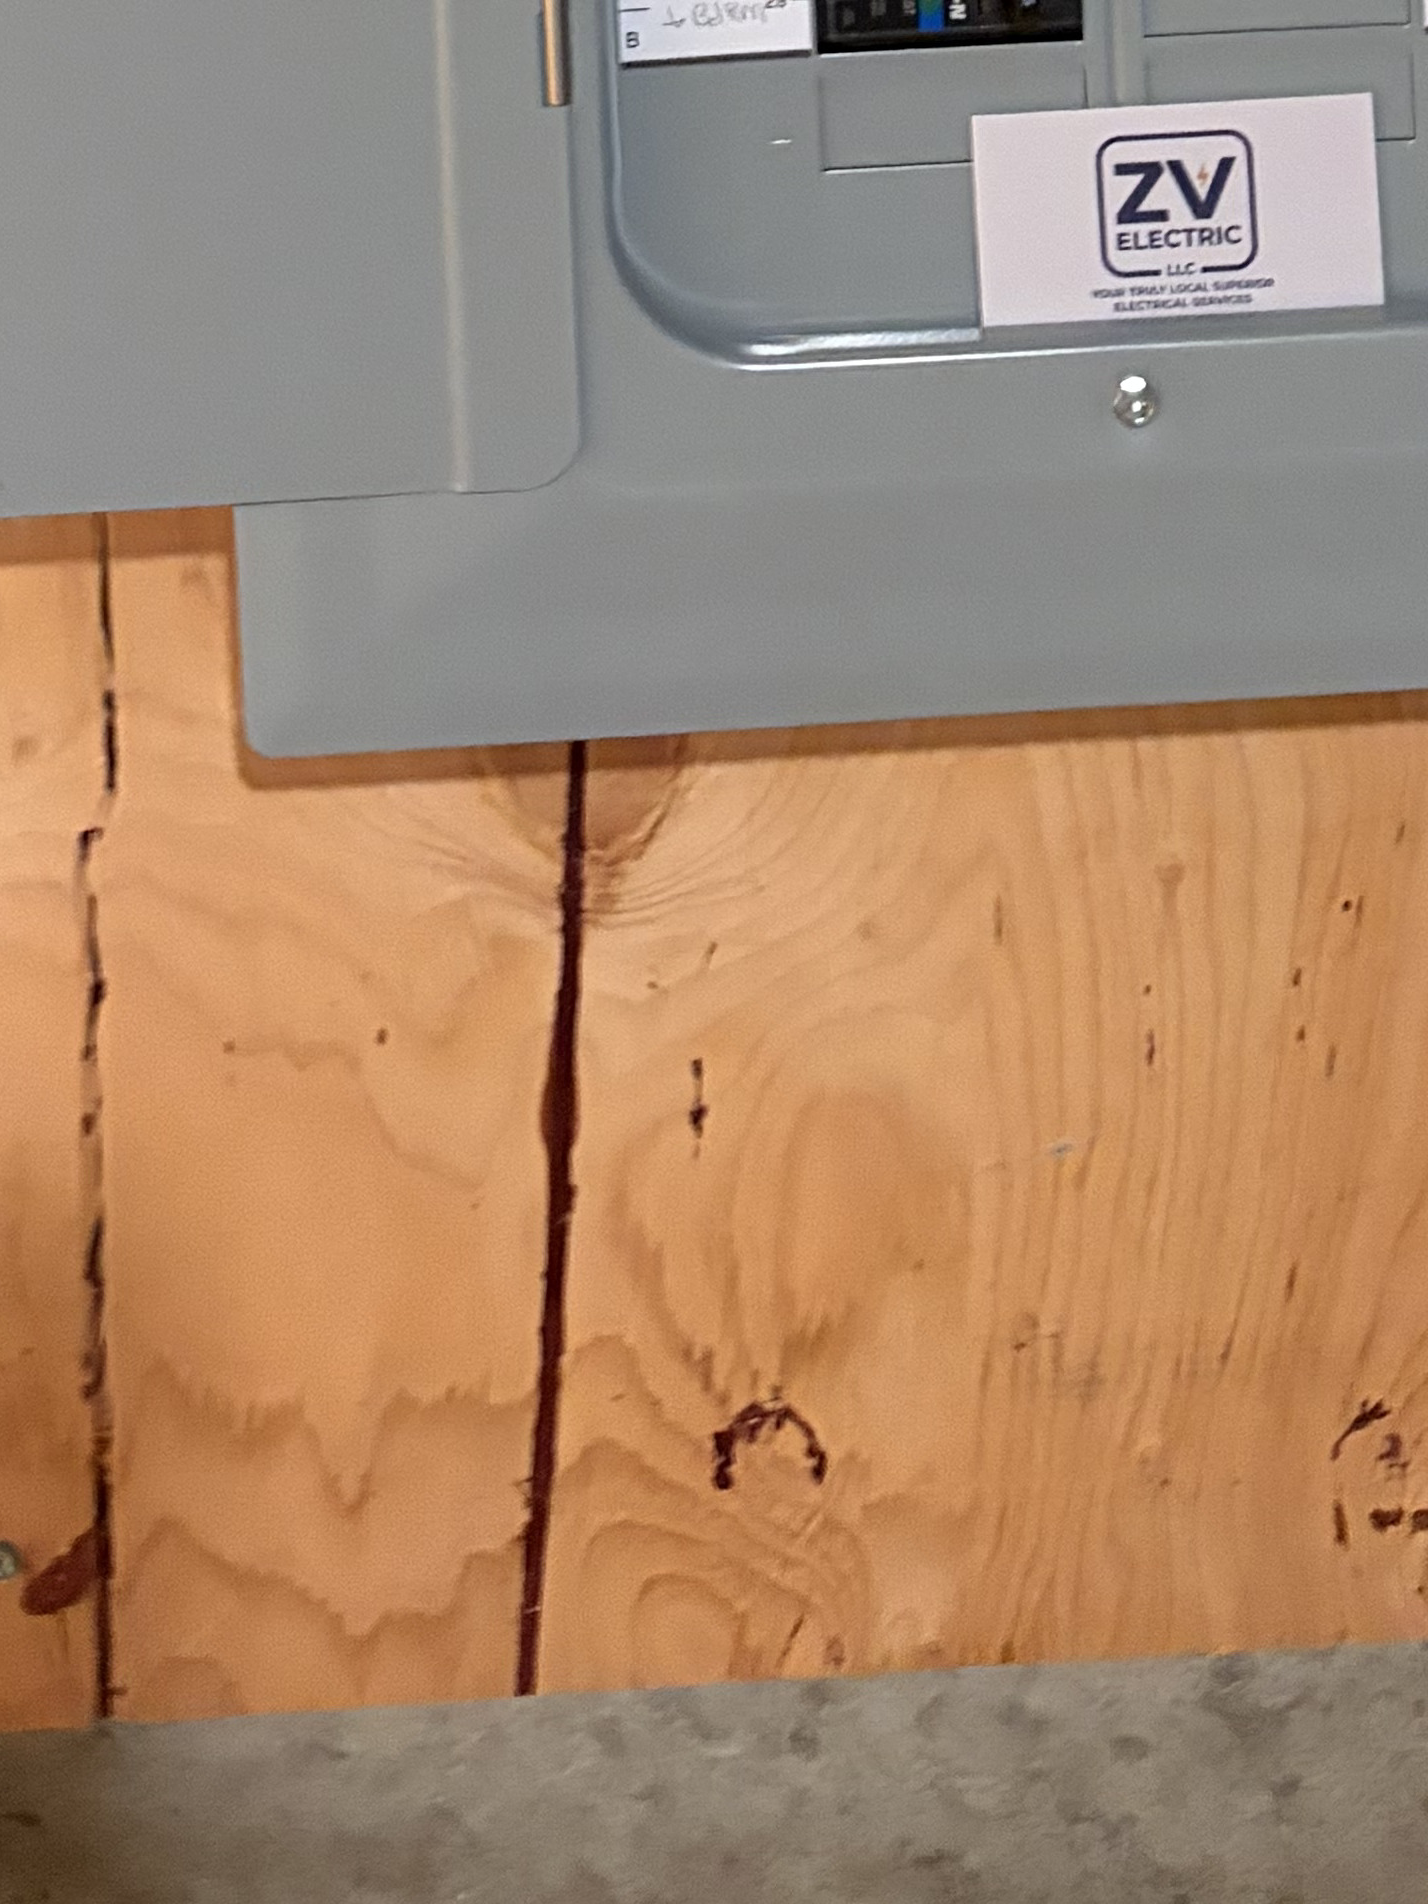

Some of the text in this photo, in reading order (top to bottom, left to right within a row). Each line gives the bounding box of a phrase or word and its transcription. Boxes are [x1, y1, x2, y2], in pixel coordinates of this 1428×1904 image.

[1113, 156, 1237, 225] ZV
[1115, 224, 1244, 252] ELECTRIC
[1165, 262, 1196, 277] LLC
[1170, 281, 1209, 294] LOCAL
[1113, 297, 1190, 313] ELECTRICAL
